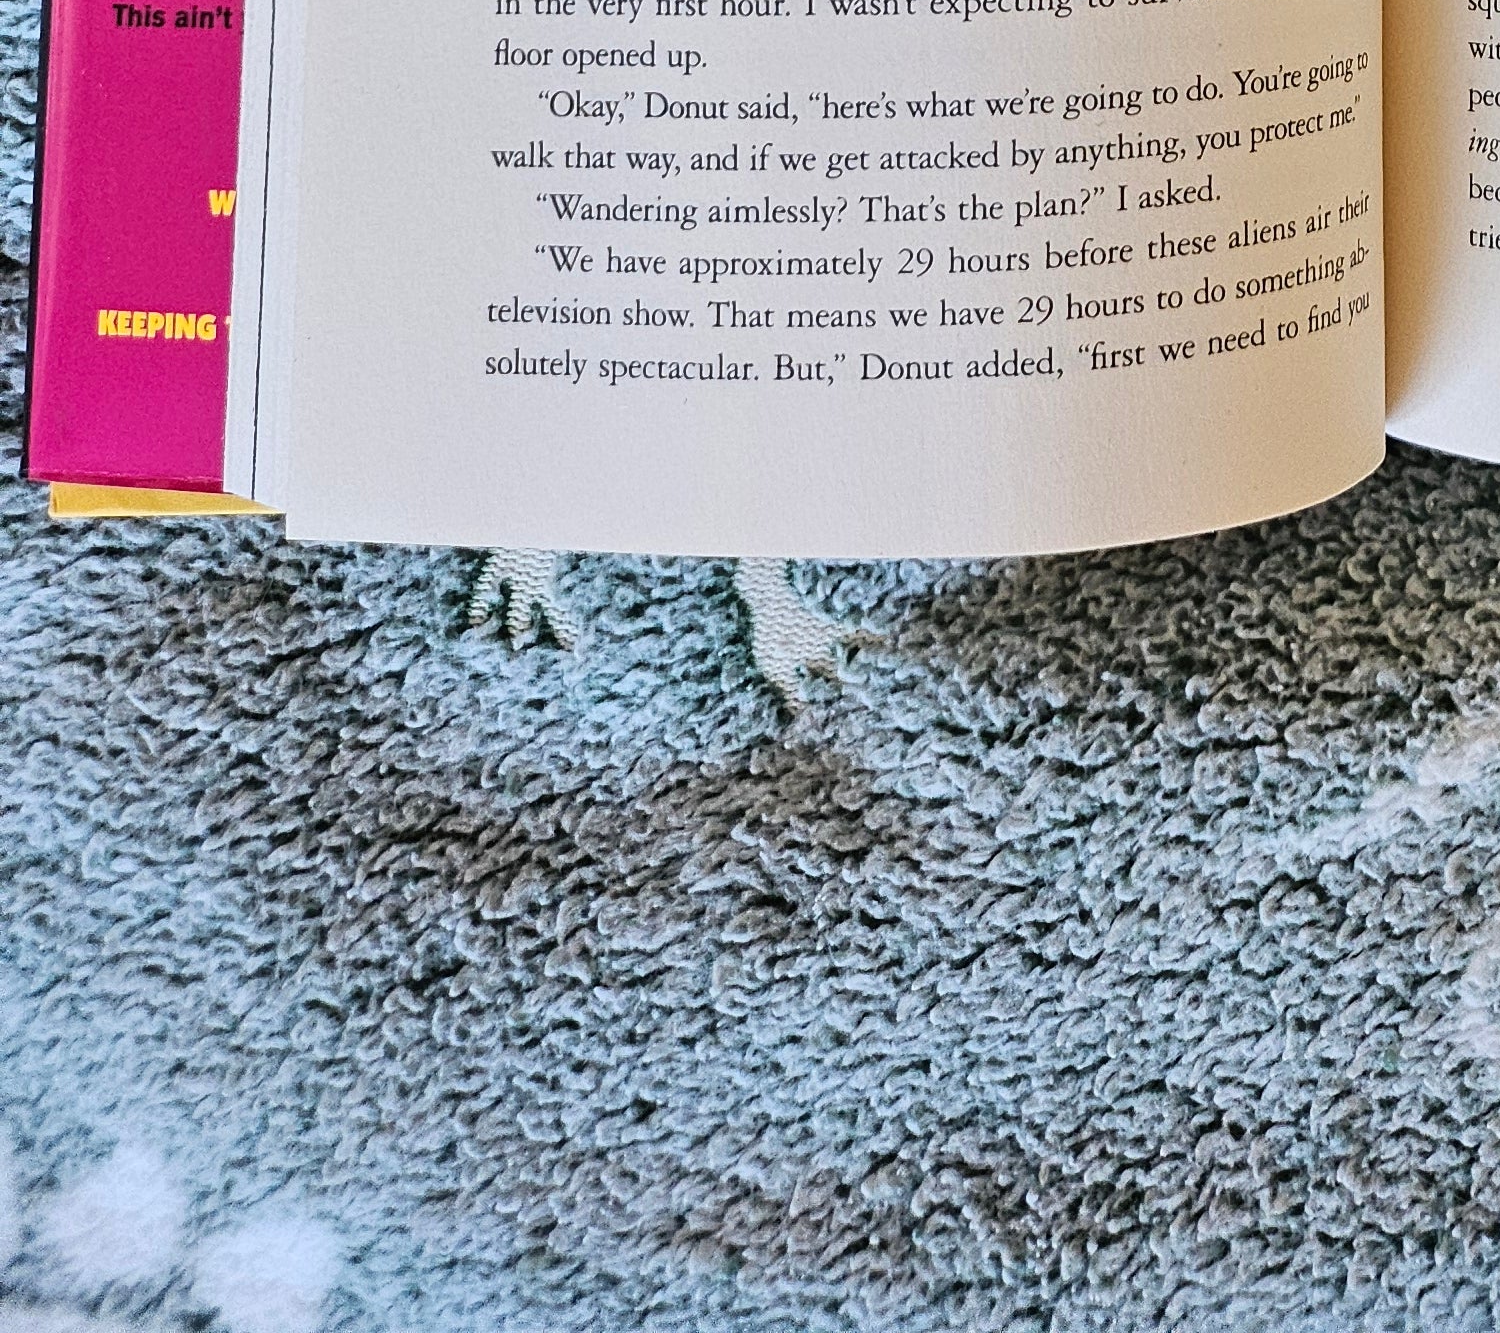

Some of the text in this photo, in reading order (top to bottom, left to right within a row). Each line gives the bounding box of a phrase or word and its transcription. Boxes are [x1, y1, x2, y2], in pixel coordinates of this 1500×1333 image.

[112, 4, 165, 29] This
[98, 309, 217, 341] KEEPING
[486, 348, 587, 384] solutely
[599, 353, 758, 386] spectacular.
[860, 353, 953, 380] Donut
[967, 346, 1063, 379] added,
[1158, 340, 1195, 363] we
[1208, 318, 1266, 356] need
[1277, 321, 1298, 341] to
[1308, 296, 1341, 335] find
[1348, 292, 1369, 326] you
